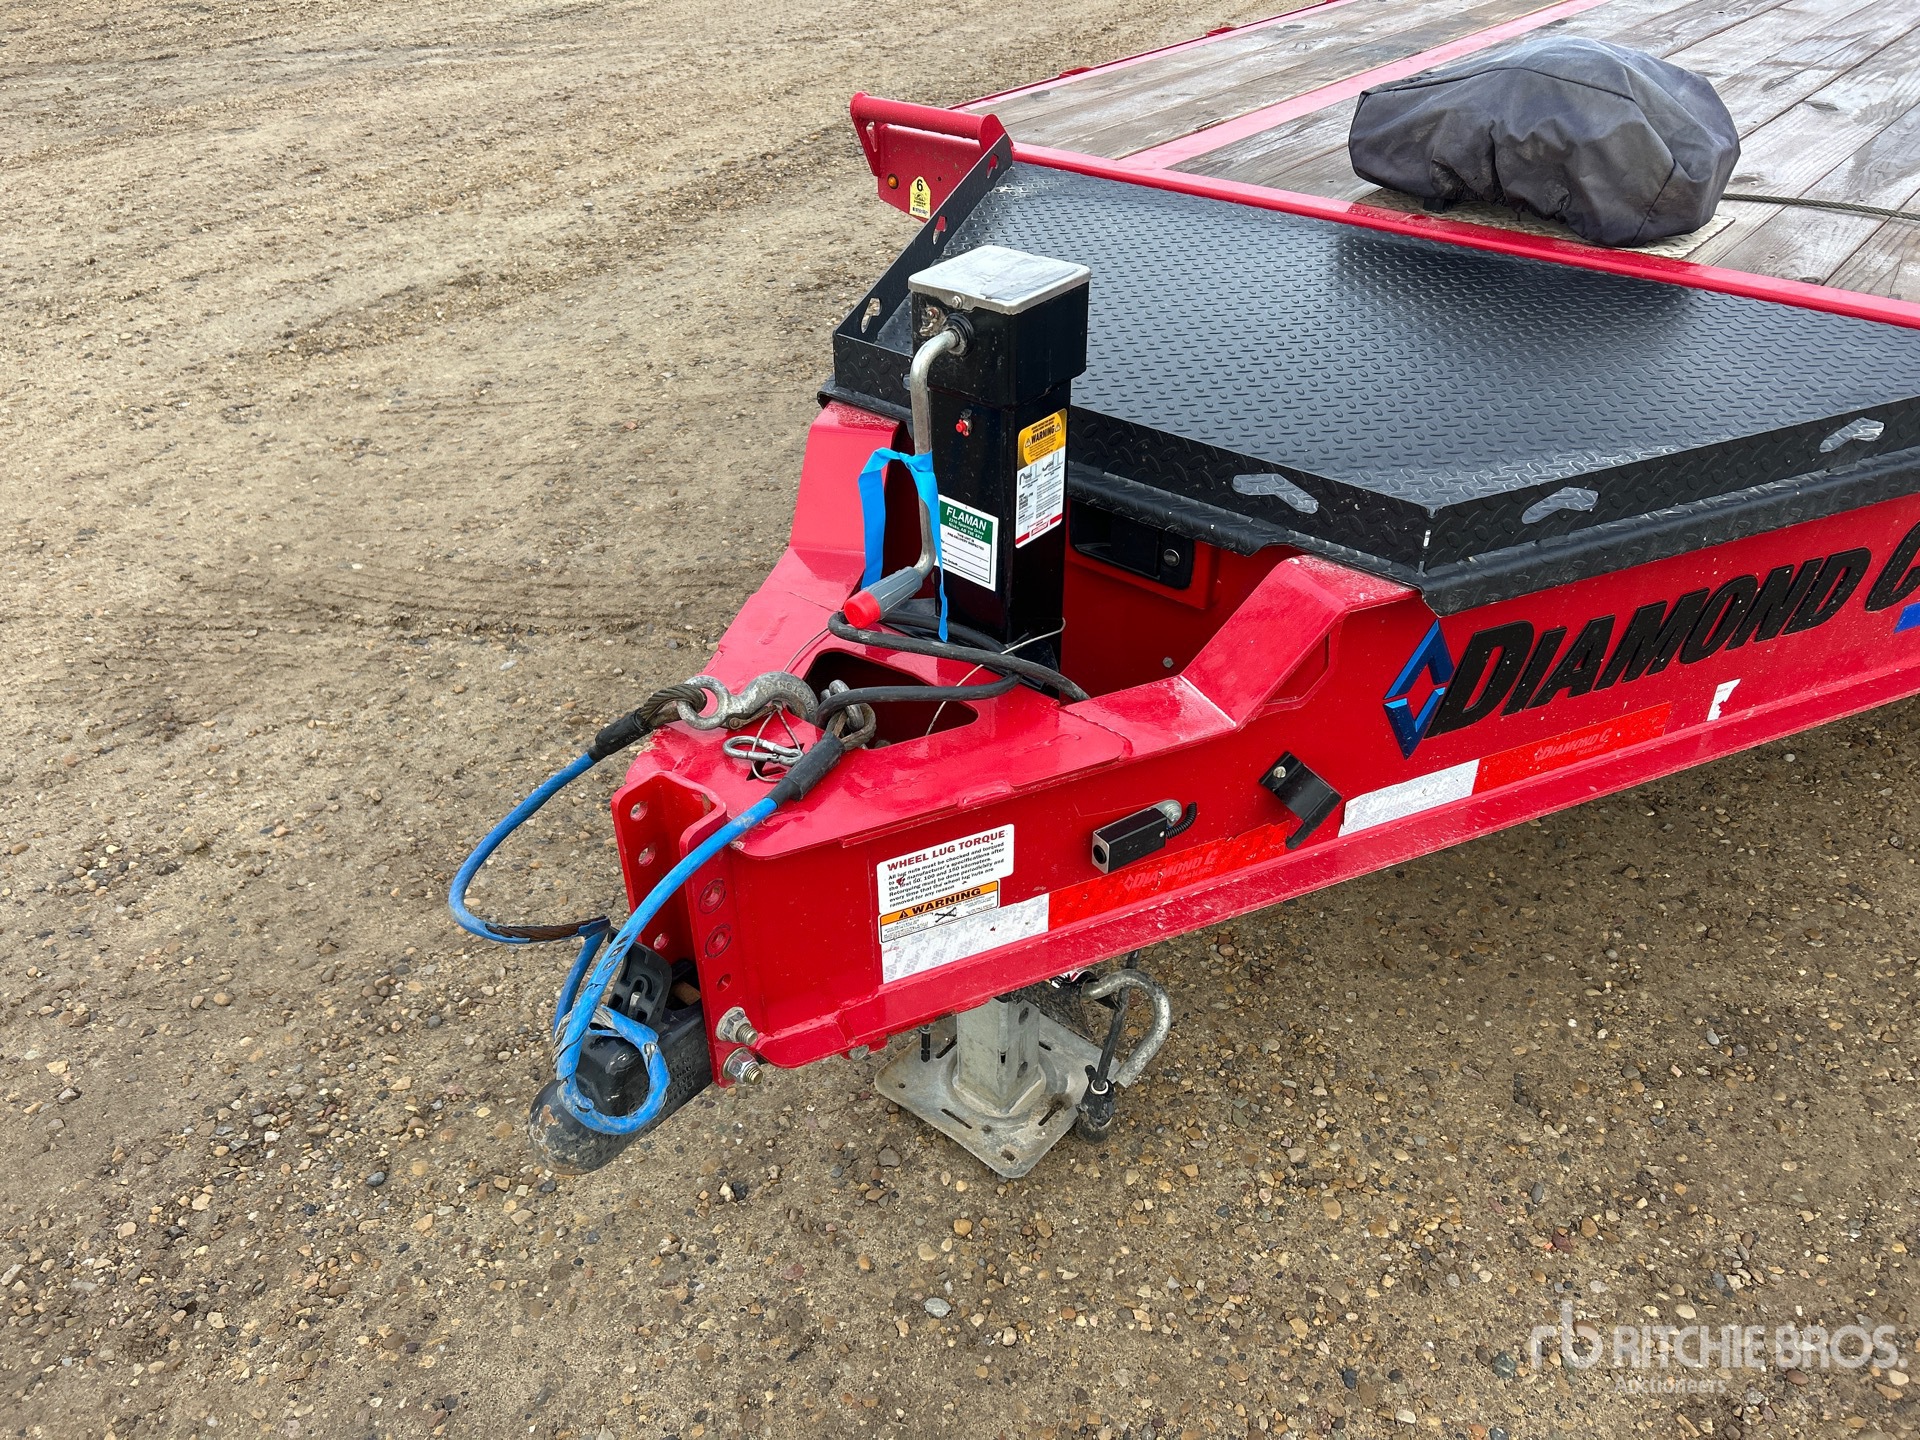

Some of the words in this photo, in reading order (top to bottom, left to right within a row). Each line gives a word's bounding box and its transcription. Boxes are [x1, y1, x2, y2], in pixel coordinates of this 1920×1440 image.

[916, 178, 923, 191] 6
[1031, 424, 1054, 444] WARNING
[946, 505, 986, 531] FLAMAN
[973, 527, 984, 535] Drive
[1424, 547, 1871, 739] DIAMOND
[1542, 734, 1597, 759] DIAMOND
[1597, 728, 1612, 742] C
[887, 852, 928, 871] WHEEL
[932, 844, 954, 858] LUG
[958, 829, 1004, 851] TORQUE
[946, 852, 969, 862] checked
[982, 841, 1004, 852] torqued
[906, 863, 949, 880] manufacturer's
[951, 851, 989, 867] specifications
[1135, 856, 1204, 886] DIAMOND
[889, 883, 920, 897] Retorquing
[922, 878, 935, 887] must
[946, 871, 959, 879] done
[889, 894, 904, 902] every
[906, 889, 918, 897] time
[943, 876, 960, 885] wheel
[970, 869, 983, 877] nuts
[890, 896, 913, 907] removed
[935, 884, 954, 893] reason
[912, 887, 980, 914] WARNING
